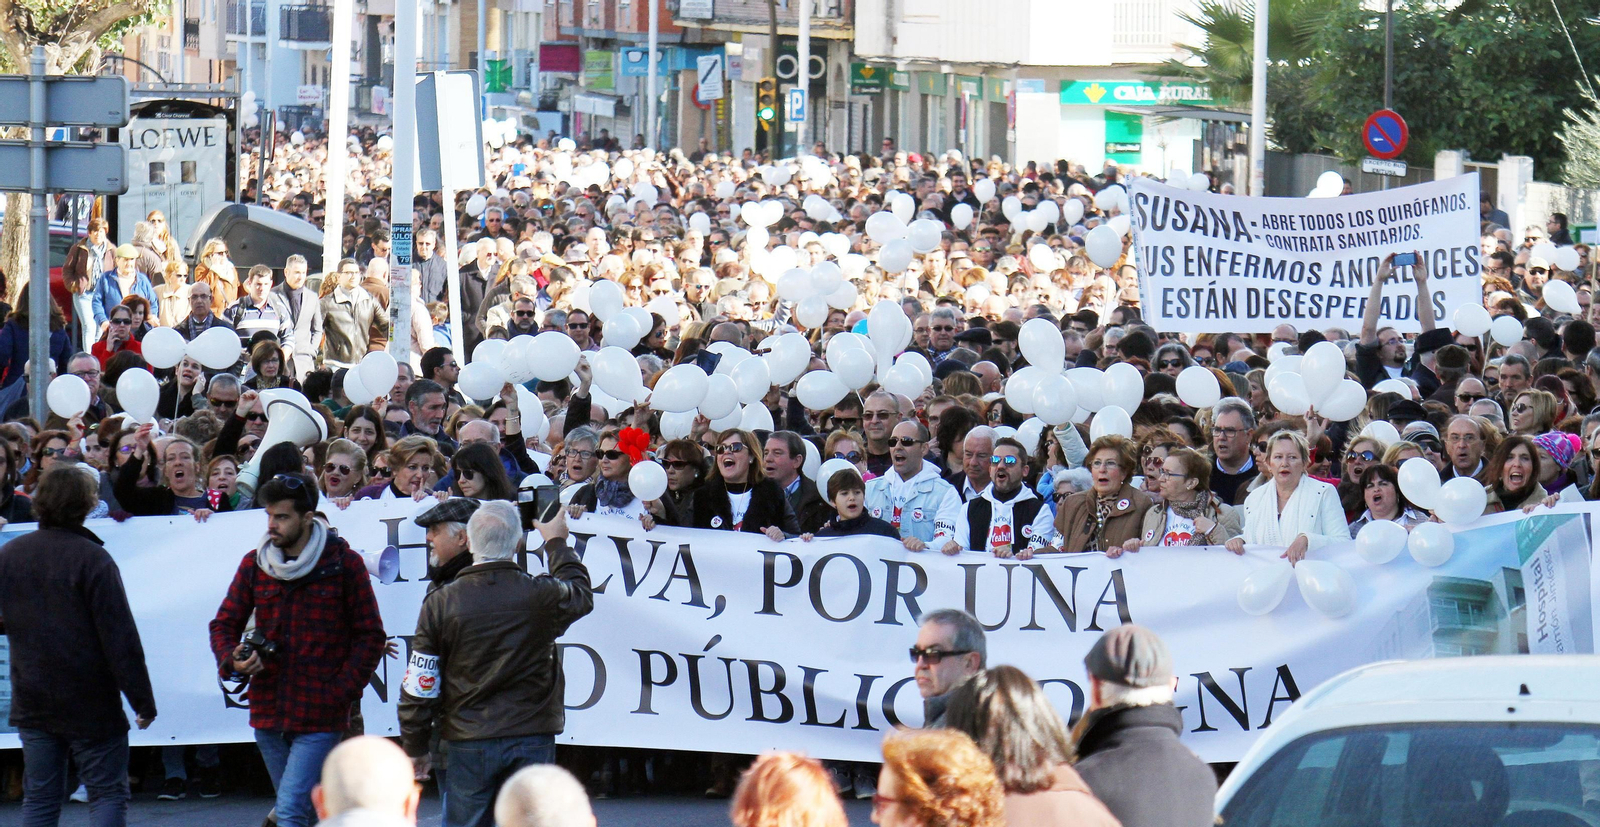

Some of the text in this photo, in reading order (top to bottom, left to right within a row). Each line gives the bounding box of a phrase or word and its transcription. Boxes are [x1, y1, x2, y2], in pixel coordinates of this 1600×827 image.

[793, 92, 803, 119] P
[1113, 85, 1213, 101] CAJA RURAL
[128, 125, 217, 150] LOEWE
[1364, 159, 1393, 168] EXCEPTO
[1135, 191, 1471, 244] SUSANA: ABRE TODOS LOS QUIRÓFANOS.
[1265, 223, 1424, 253] CONTRATA SANITARIOS.
[1141, 245, 1175, 277] US
[1183, 245, 1323, 286] ENFERMOS
[1161, 280, 1237, 319] ESTÁN
[379, 516, 1134, 633] HELVA, POR UNA
[1530, 557, 1549, 643] Hospital
[1550, 607, 1564, 654] amón
[630, 633, 917, 732] PÚBLIC
[1037, 663, 1302, 737] DNA
